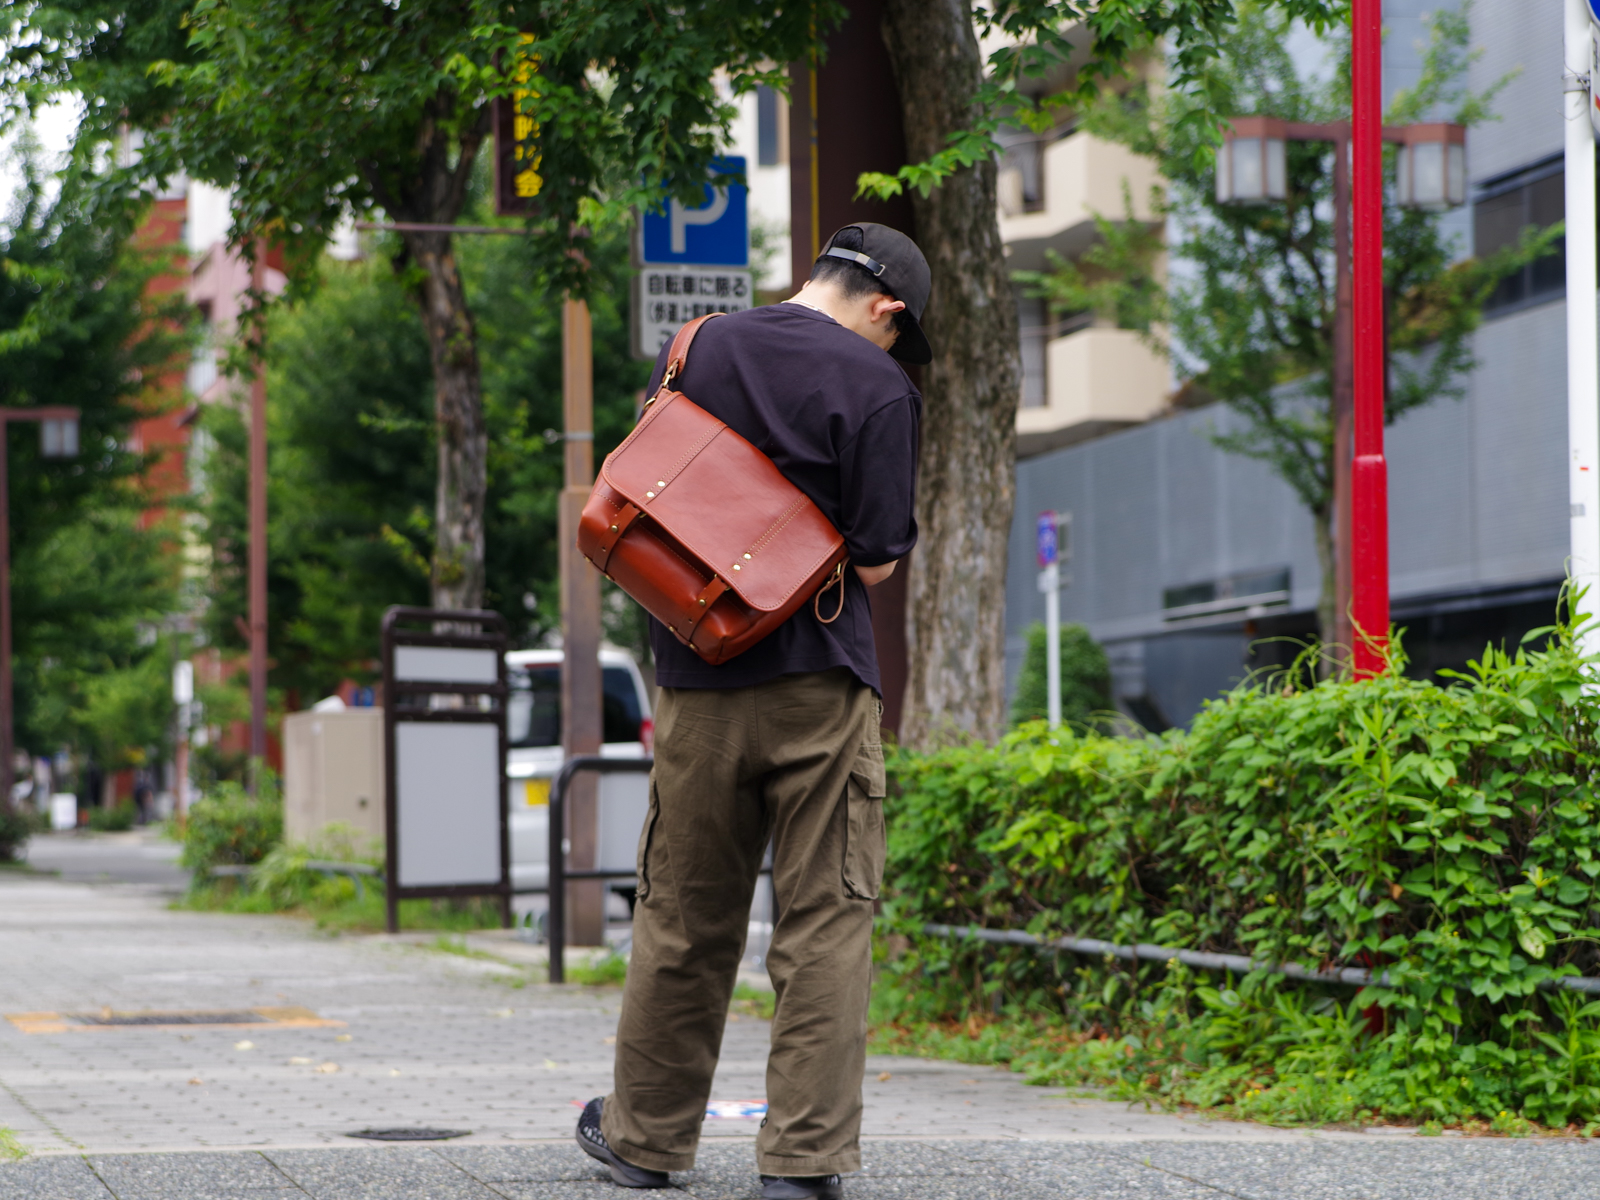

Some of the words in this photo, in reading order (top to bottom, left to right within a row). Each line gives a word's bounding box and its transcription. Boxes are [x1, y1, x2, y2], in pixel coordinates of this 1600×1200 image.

[671, 167, 729, 253] P
[649, 274, 748, 297] 自転車に限る
